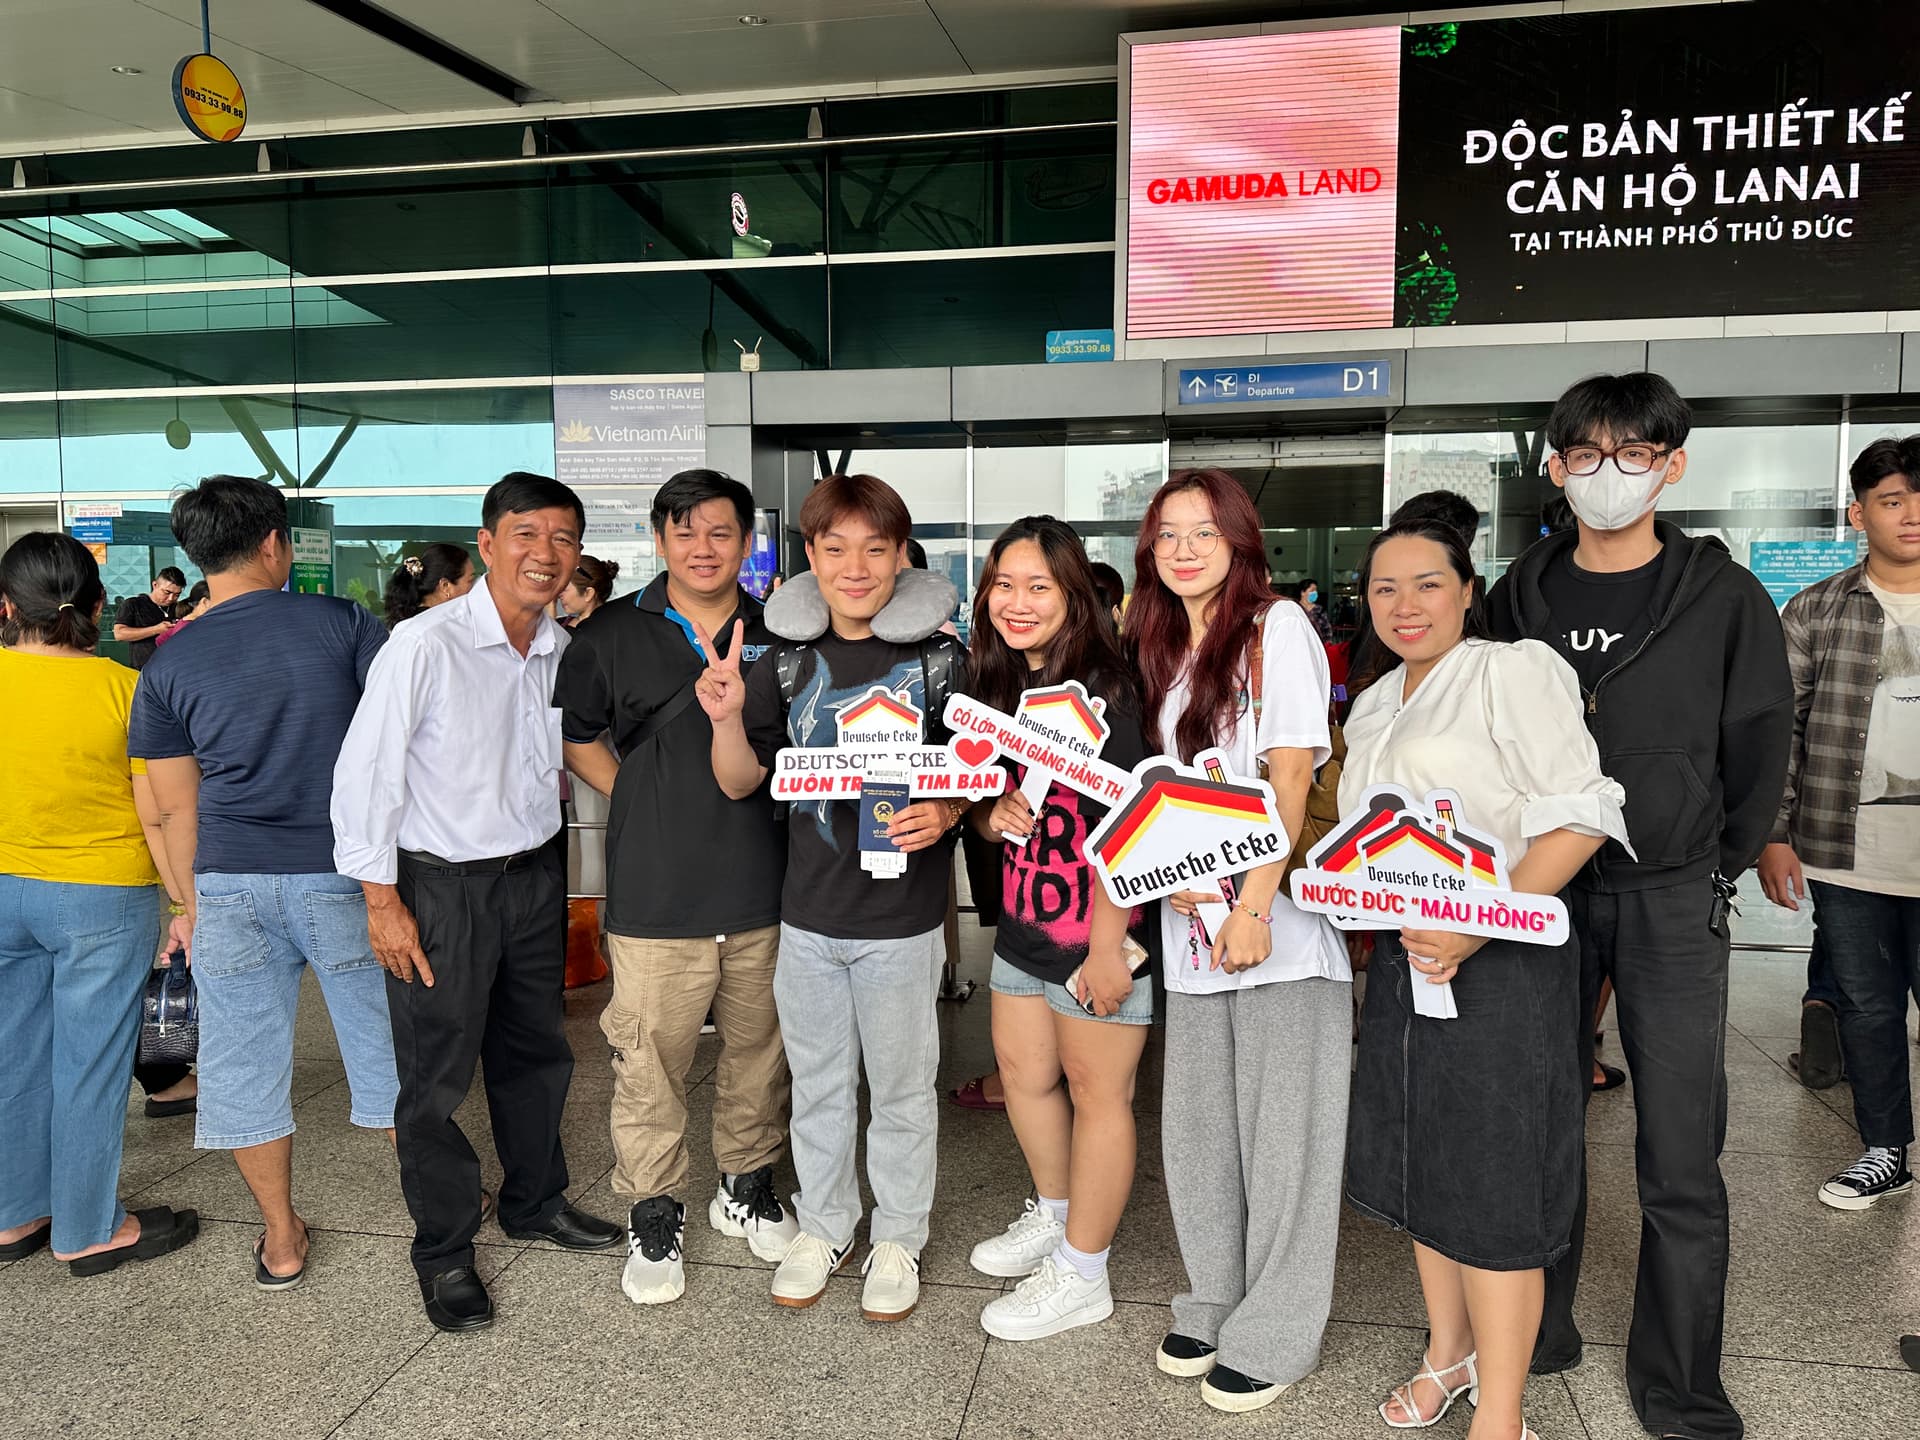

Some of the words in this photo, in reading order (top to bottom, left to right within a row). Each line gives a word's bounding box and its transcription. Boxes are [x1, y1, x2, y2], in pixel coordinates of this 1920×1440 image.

[1463, 119, 1569, 171] ĐỘC
[1582, 109, 1679, 157] BẢN
[1693, 97, 1835, 151] THIẾT
[1847, 91, 1912, 144] KẾ
[1146, 172, 1288, 204] GAMUDA
[1299, 167, 1382, 196] LAND
[1506, 170, 1605, 214] CĂN
[1623, 163, 1697, 216] HỘ
[1714, 163, 1860, 205] LANAI
[1510, 231, 1550, 256] TẠI
[1559, 224, 1653, 250] THÀNH
[1662, 217, 1719, 246] PHỐ
[1726, 215, 1784, 242] THỦ
[1792, 214, 1853, 240] ĐỨC
[610, 388, 654, 400] SASCO
[1247, 386, 1295, 397] Departure
[1248, 373, 1260, 383] ĐI
[1343, 367, 1378, 392] D1
[594, 425, 667, 442] Vietnam
[1562, 628, 1625, 653] UY
[842, 730, 890, 744] Deutsche
[893, 730, 918, 743] Ecke
[952, 707, 972, 726] CÓ
[996, 728, 1028, 755] KHAI
[1018, 711, 1067, 745] Deutsche
[1068, 736, 1095, 759] Ecke
[778, 773, 830, 793] LUÔN
[917, 774, 951, 790] TIM
[957, 773, 1000, 794] BẠN
[1111, 851, 1218, 900] Deutsche
[1219, 832, 1279, 866] Ecke
[1367, 865, 1429, 888] Deutsche
[1432, 872, 1466, 892] Ecke
[1301, 882, 1357, 908] NƯỚC
[1361, 888, 1406, 914] ĐỨC
